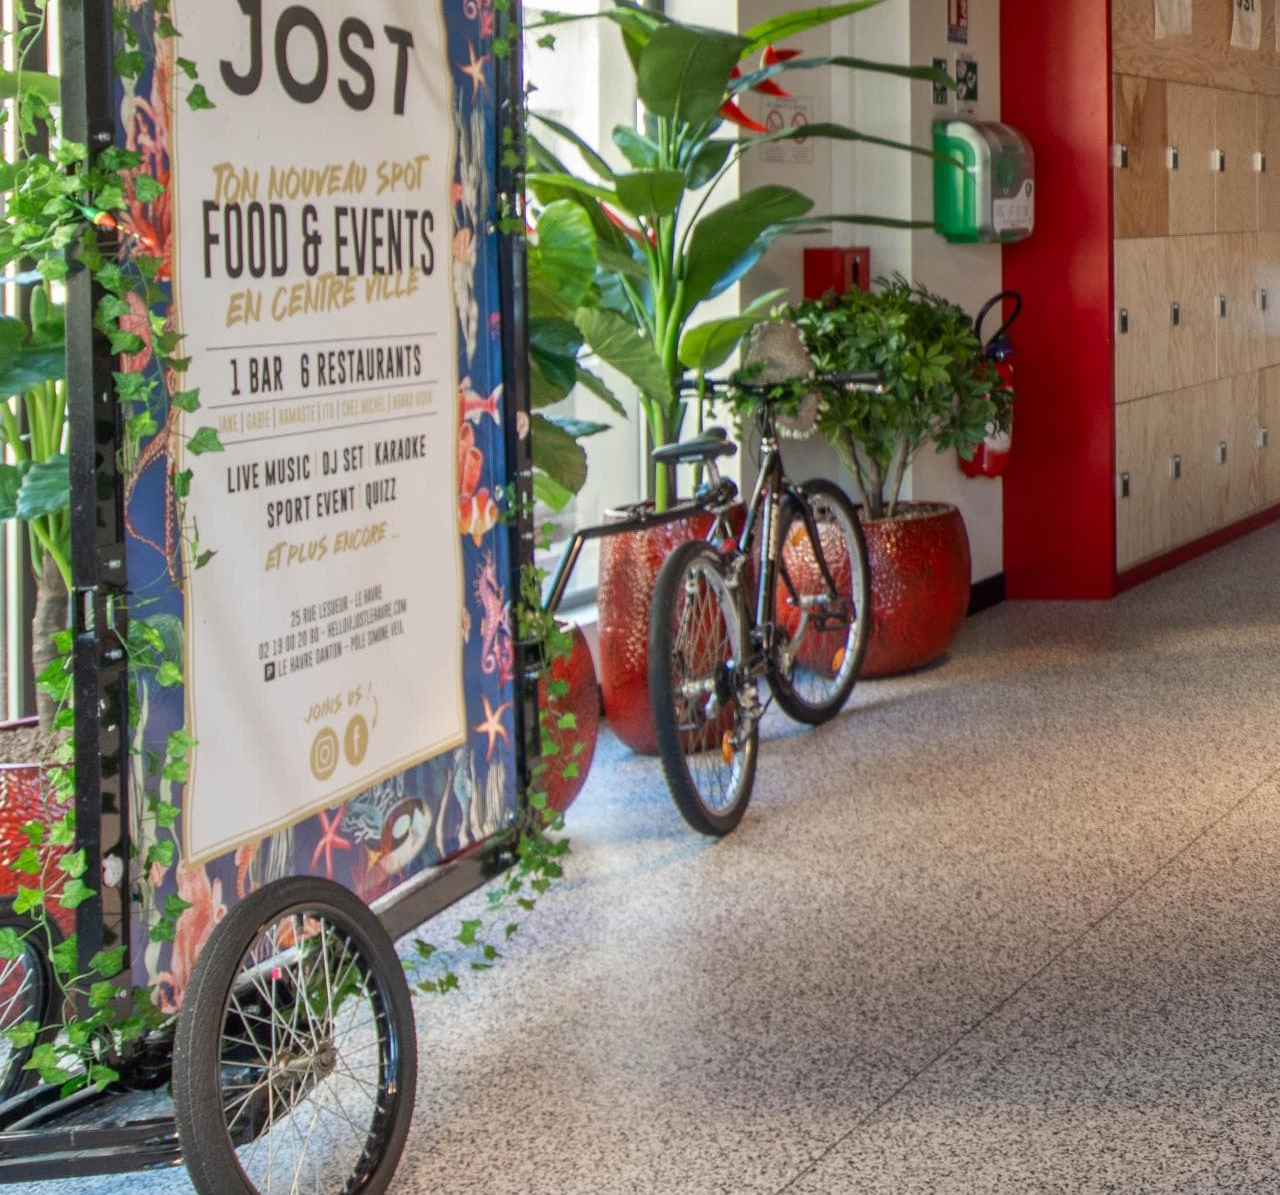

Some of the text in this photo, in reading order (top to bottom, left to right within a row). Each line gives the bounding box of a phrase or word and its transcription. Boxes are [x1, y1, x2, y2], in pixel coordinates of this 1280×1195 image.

[212, 154, 431, 205] TON NOUVEAU SPOT
[202, 199, 435, 279] FOOD & EVENTS
[225, 266, 421, 327] EN CENTRE VILLE
[230, 344, 422, 396] 1 BAR 6 RESTAURANTS
[227, 434, 426, 494] LIVE MUSIC DJ SET KARAOKE
[267, 477, 396, 529] SPORT EVENT QUIZZ
[265, 541, 287, 572] ET
[287, 535, 328, 567] PLUS
[333, 521, 388, 554] ENCORE
[290, 610, 301, 628] 25
[303, 604, 317, 624] RUE
[355, 590, 363, 608] LE
[364, 584, 383, 604] HAVRE
[258, 641, 270, 661] 02
[285, 632, 296, 652] 00
[297, 628, 308, 649] 20
[277, 659, 287, 678] LE
[289, 652, 313, 674] HAVRE
[315, 641, 342, 665] DANTON
[347, 685, 363, 706] US
